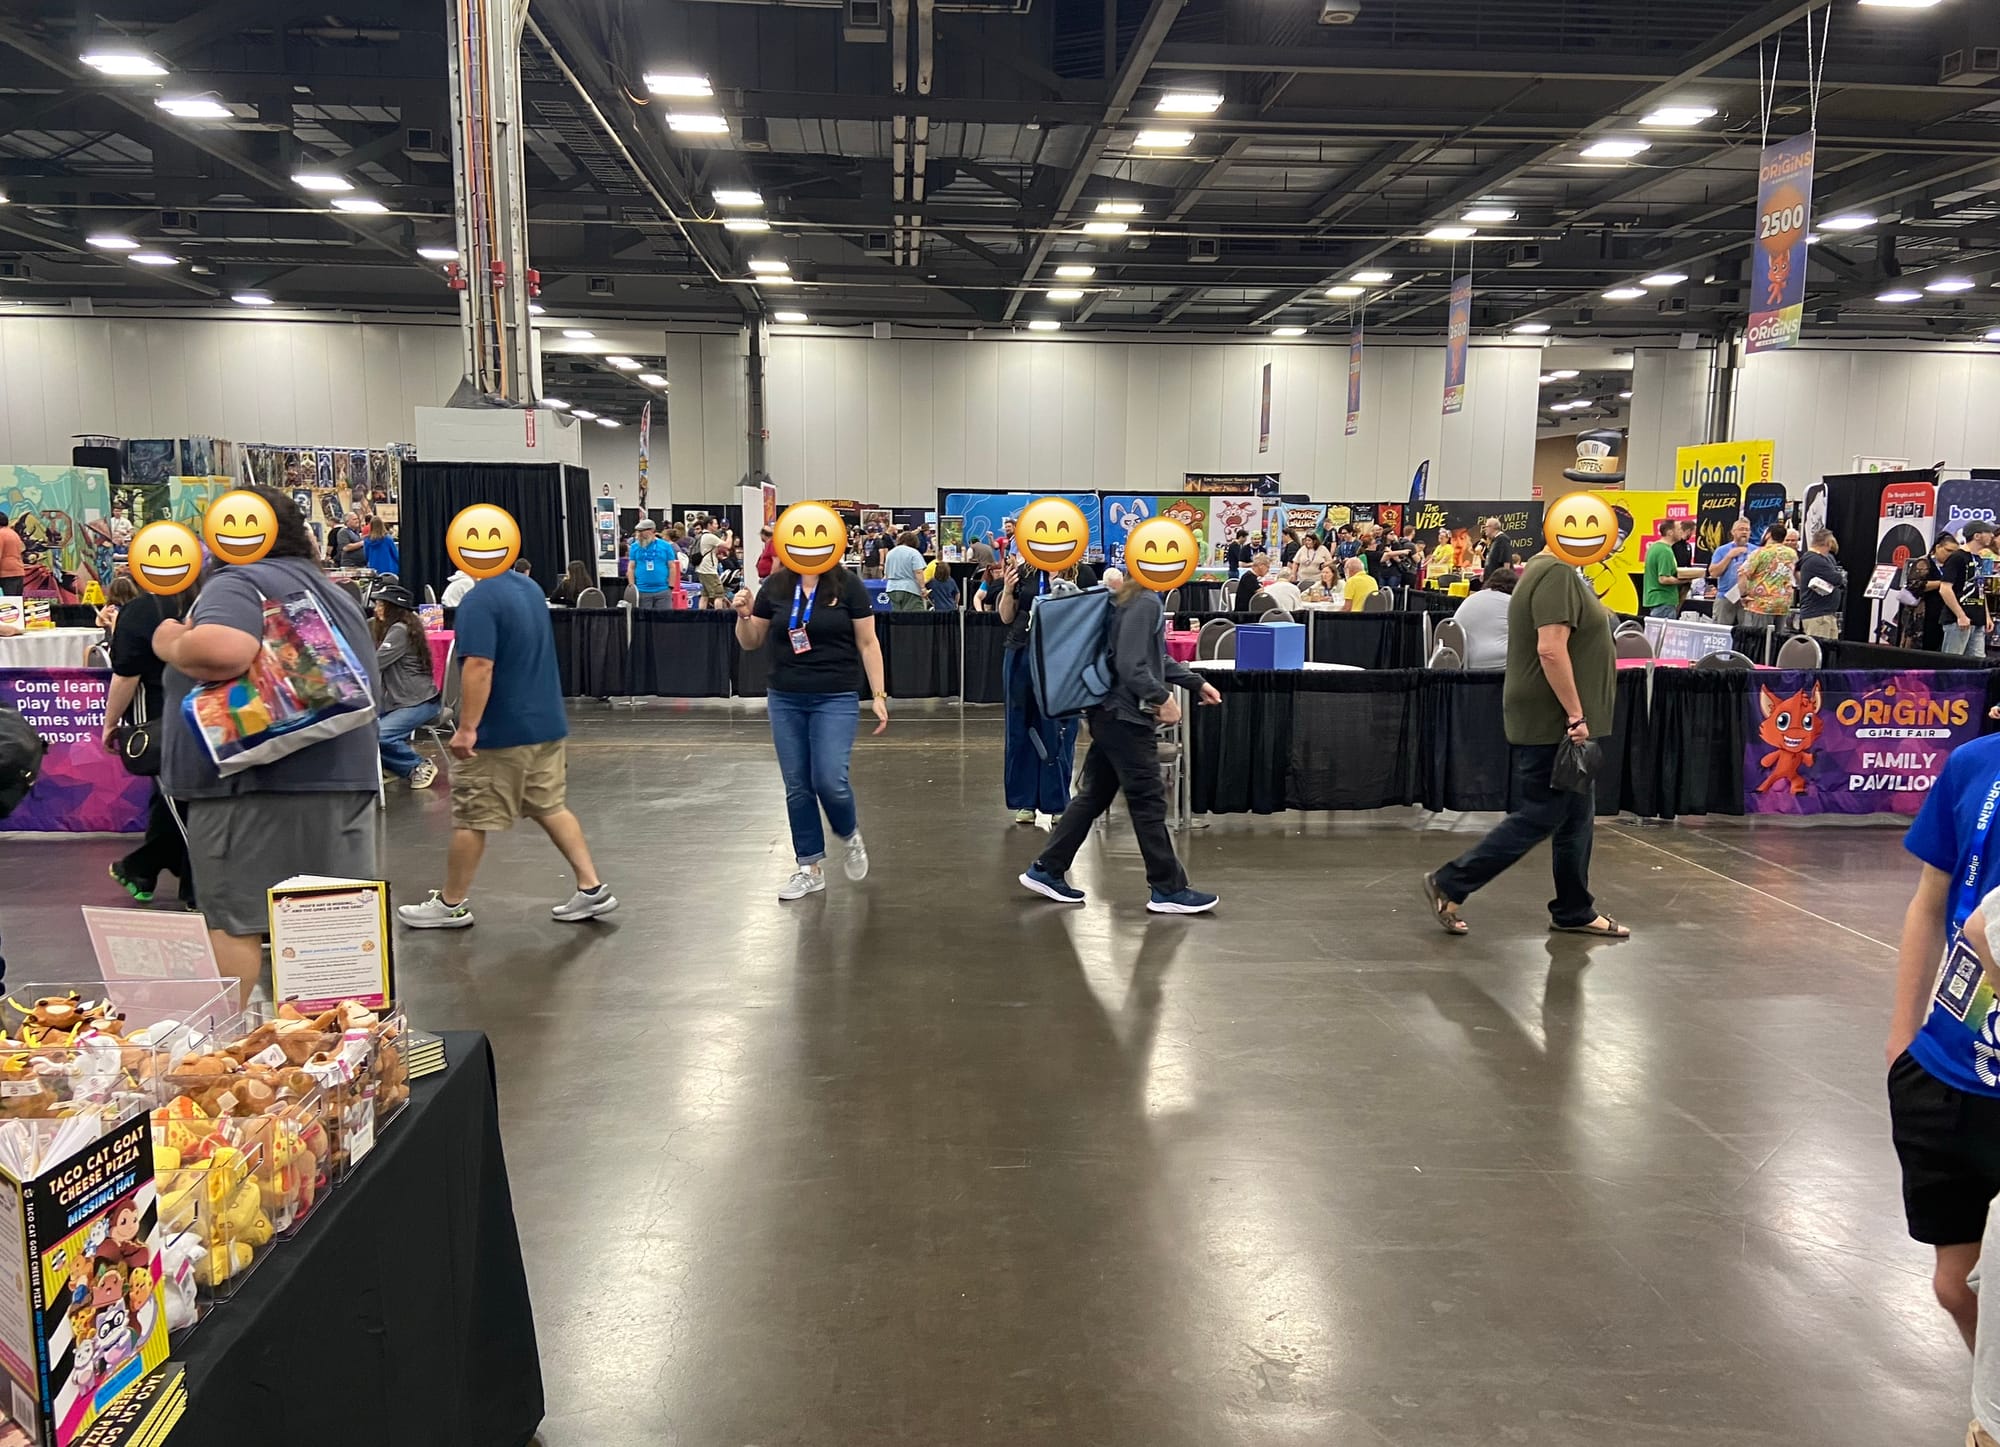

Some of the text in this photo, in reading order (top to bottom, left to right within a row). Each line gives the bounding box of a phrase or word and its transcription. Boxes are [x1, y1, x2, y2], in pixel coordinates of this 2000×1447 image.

[1759, 203, 1804, 240] 2500
[1682, 454, 1746, 488] uloomi
[1758, 453, 1770, 483] oomi
[1504, 511, 1529, 523] WITH
[1668, 506, 1687, 518] OUR
[1702, 497, 1737, 511] KILLER
[1749, 497, 1783, 511] KILLER
[15, 679, 105, 693] Come learn
[17, 696, 106, 712] play the lat
[1907, 729, 1936, 737] FAIR
[1862, 752, 1937, 769] FAMILY
[1965, 855, 1979, 887] allplay
[49, 1125, 144, 1195] TACO CAT GOAT
[59, 1146, 140, 1205] CHEESE PIZZA
[67, 1172, 137, 1228] MISSING HAT
[26, 1203, 42, 1309] TACO CAT GOAT CHEESE PIZZA
[136, 1373, 166, 1400] TACO
[116, 1403, 142, 1423] CAT
[80, 1420, 114, 1447] PIZZ
